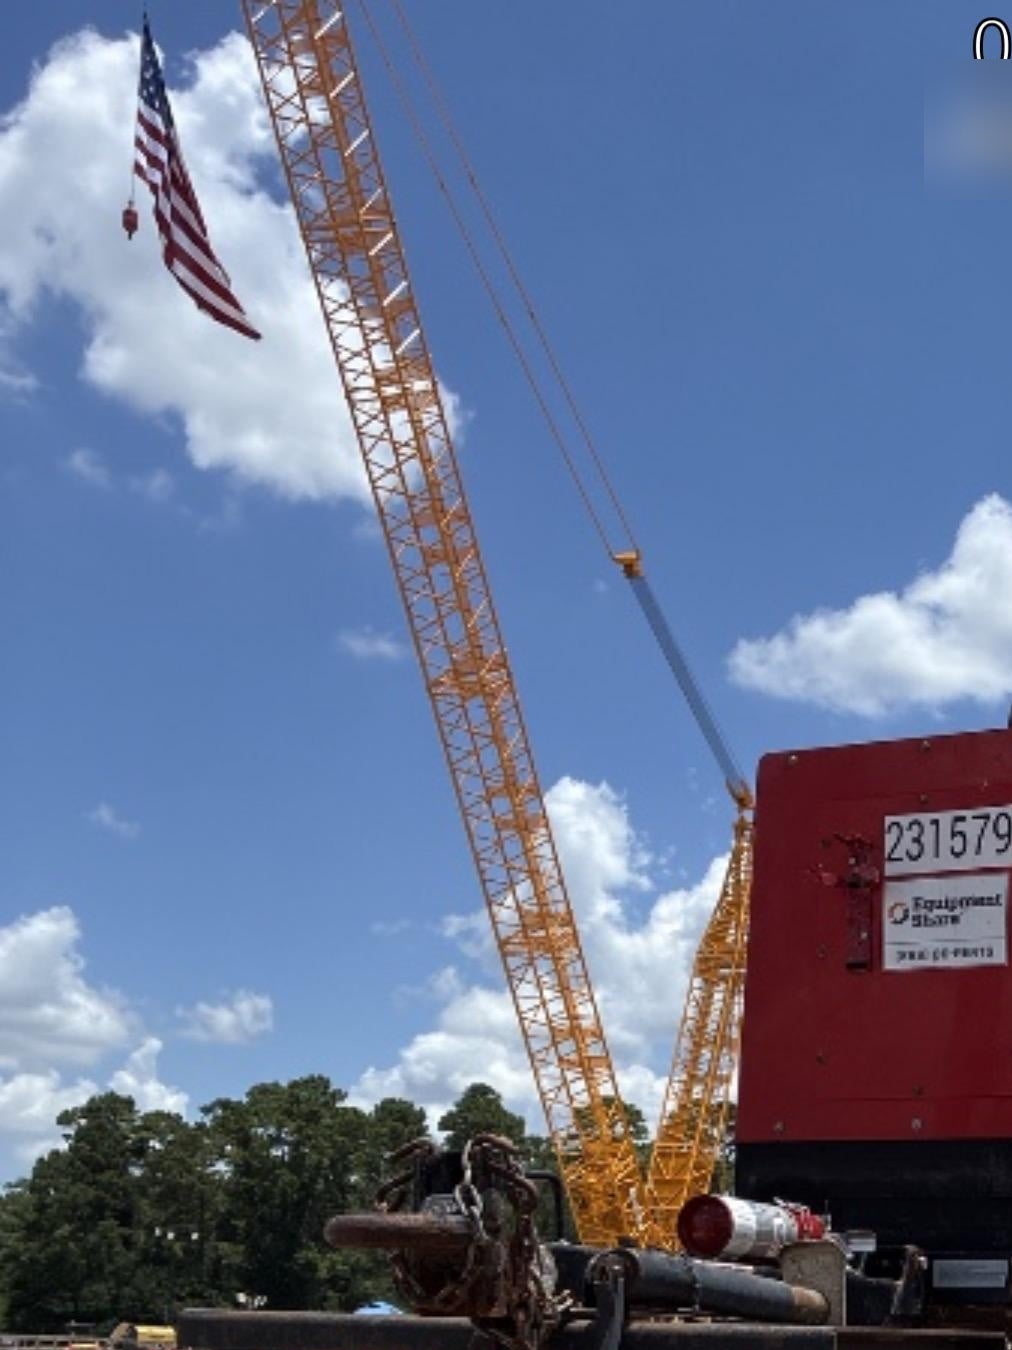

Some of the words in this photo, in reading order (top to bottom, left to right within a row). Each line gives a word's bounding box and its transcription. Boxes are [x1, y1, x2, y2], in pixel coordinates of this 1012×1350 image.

[886, 812, 1012, 862] 231579
[911, 894, 1003, 912] Equipment
[911, 913, 961, 928] Share
